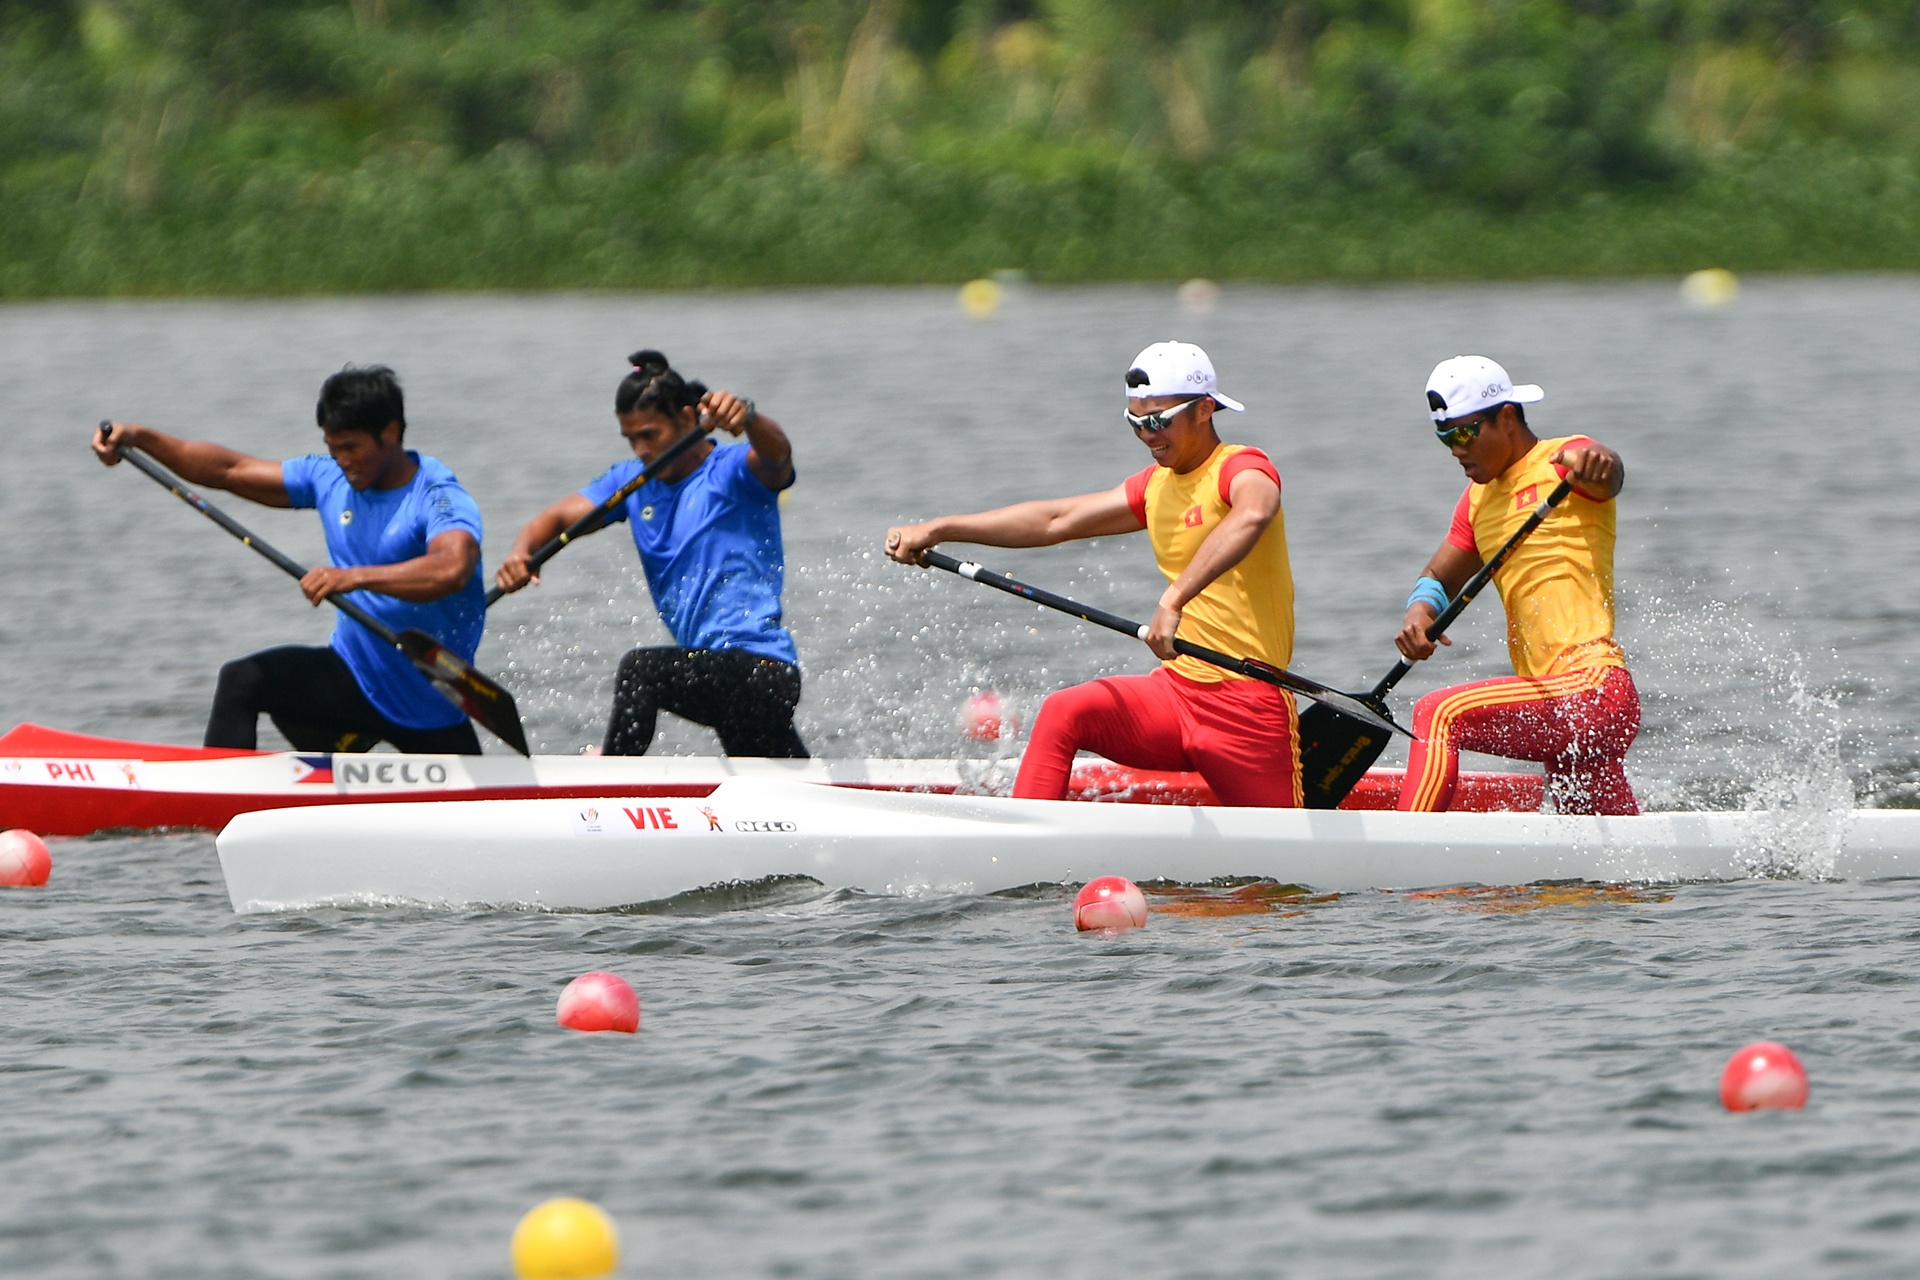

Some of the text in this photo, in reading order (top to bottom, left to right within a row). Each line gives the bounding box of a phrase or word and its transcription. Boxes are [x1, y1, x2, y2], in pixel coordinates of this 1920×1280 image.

[1481, 383, 1504, 398] ONE
[45, 763, 95, 781] PHI
[343, 763, 446, 783] NELO
[623, 807, 678, 830] VIE
[736, 821, 797, 833] NELO
